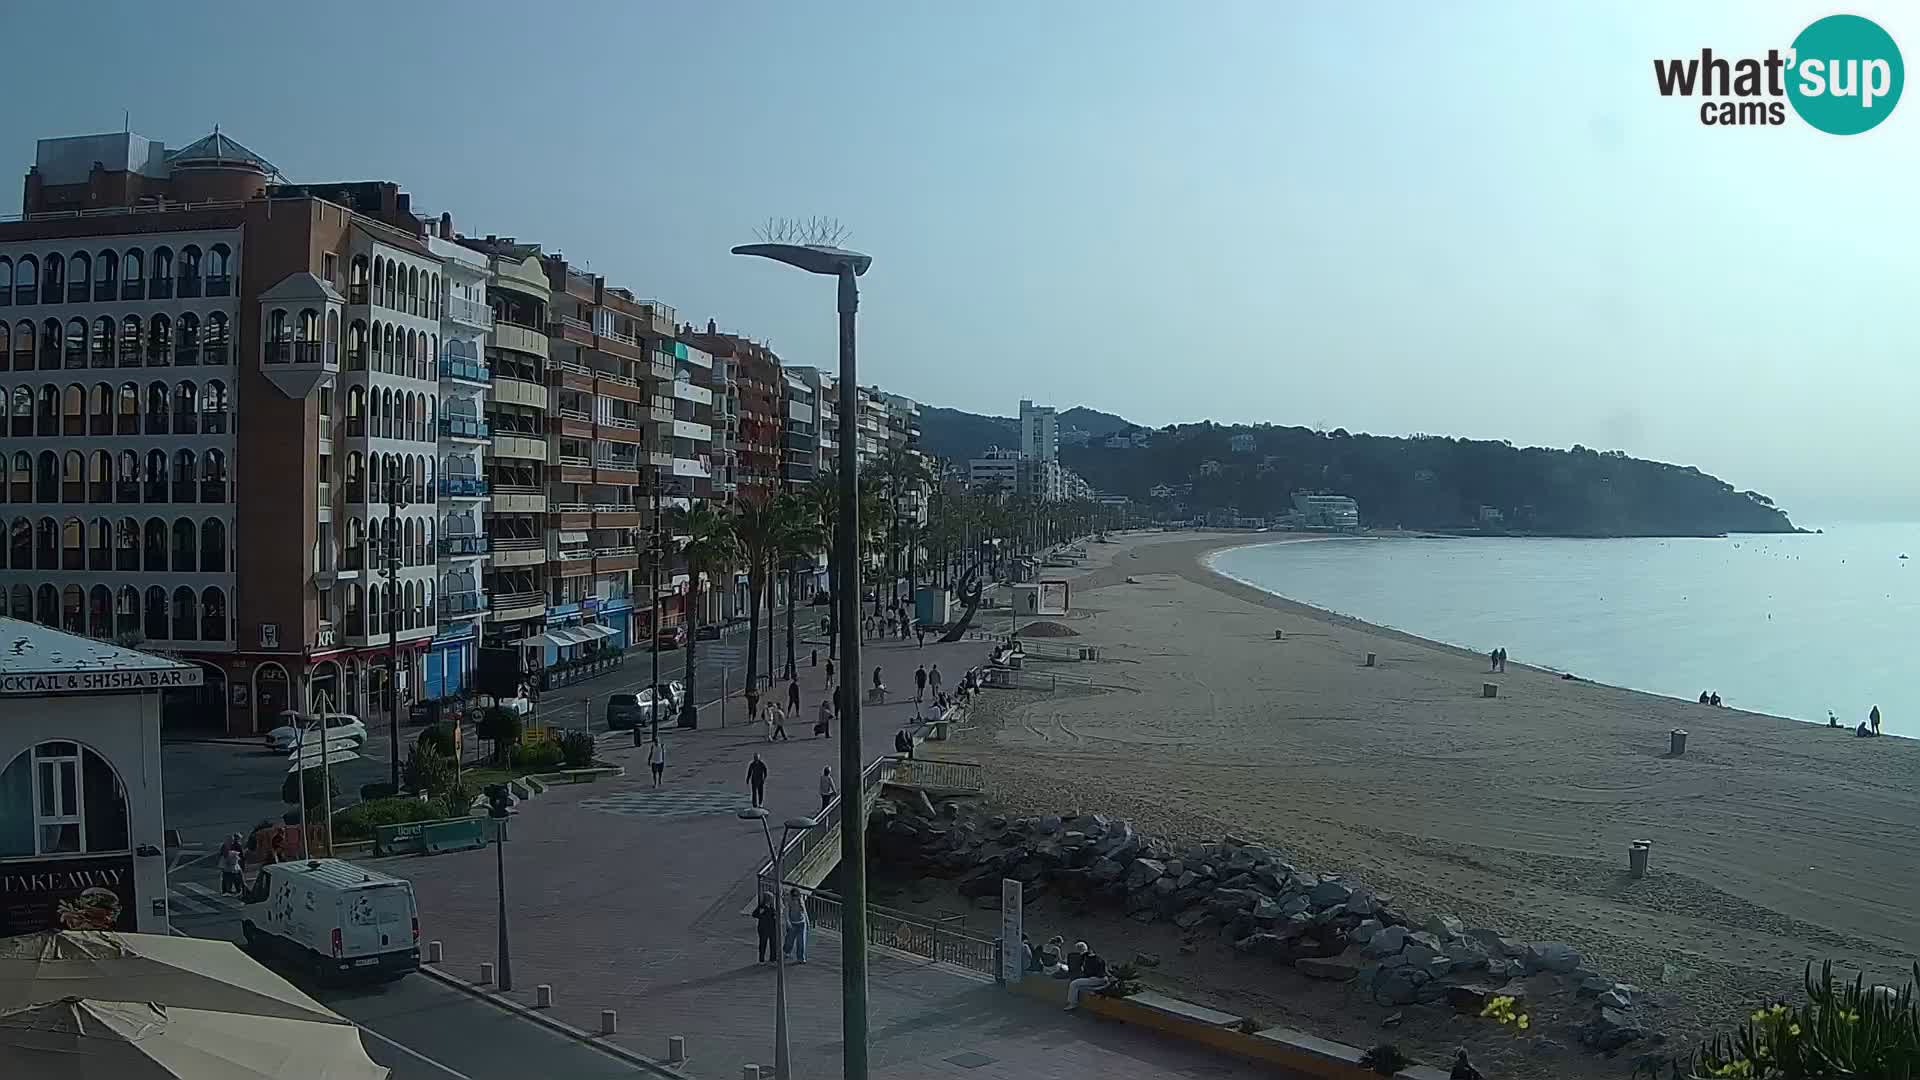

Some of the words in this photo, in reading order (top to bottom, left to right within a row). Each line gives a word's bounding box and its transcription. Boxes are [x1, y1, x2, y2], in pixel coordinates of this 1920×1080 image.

[318, 630, 336, 647] KFC
[0, 675, 62, 690] CKTAIL
[68, 674, 78, 689] &
[83, 672, 145, 689] SHISHA
[150, 671, 182, 685] BAR
